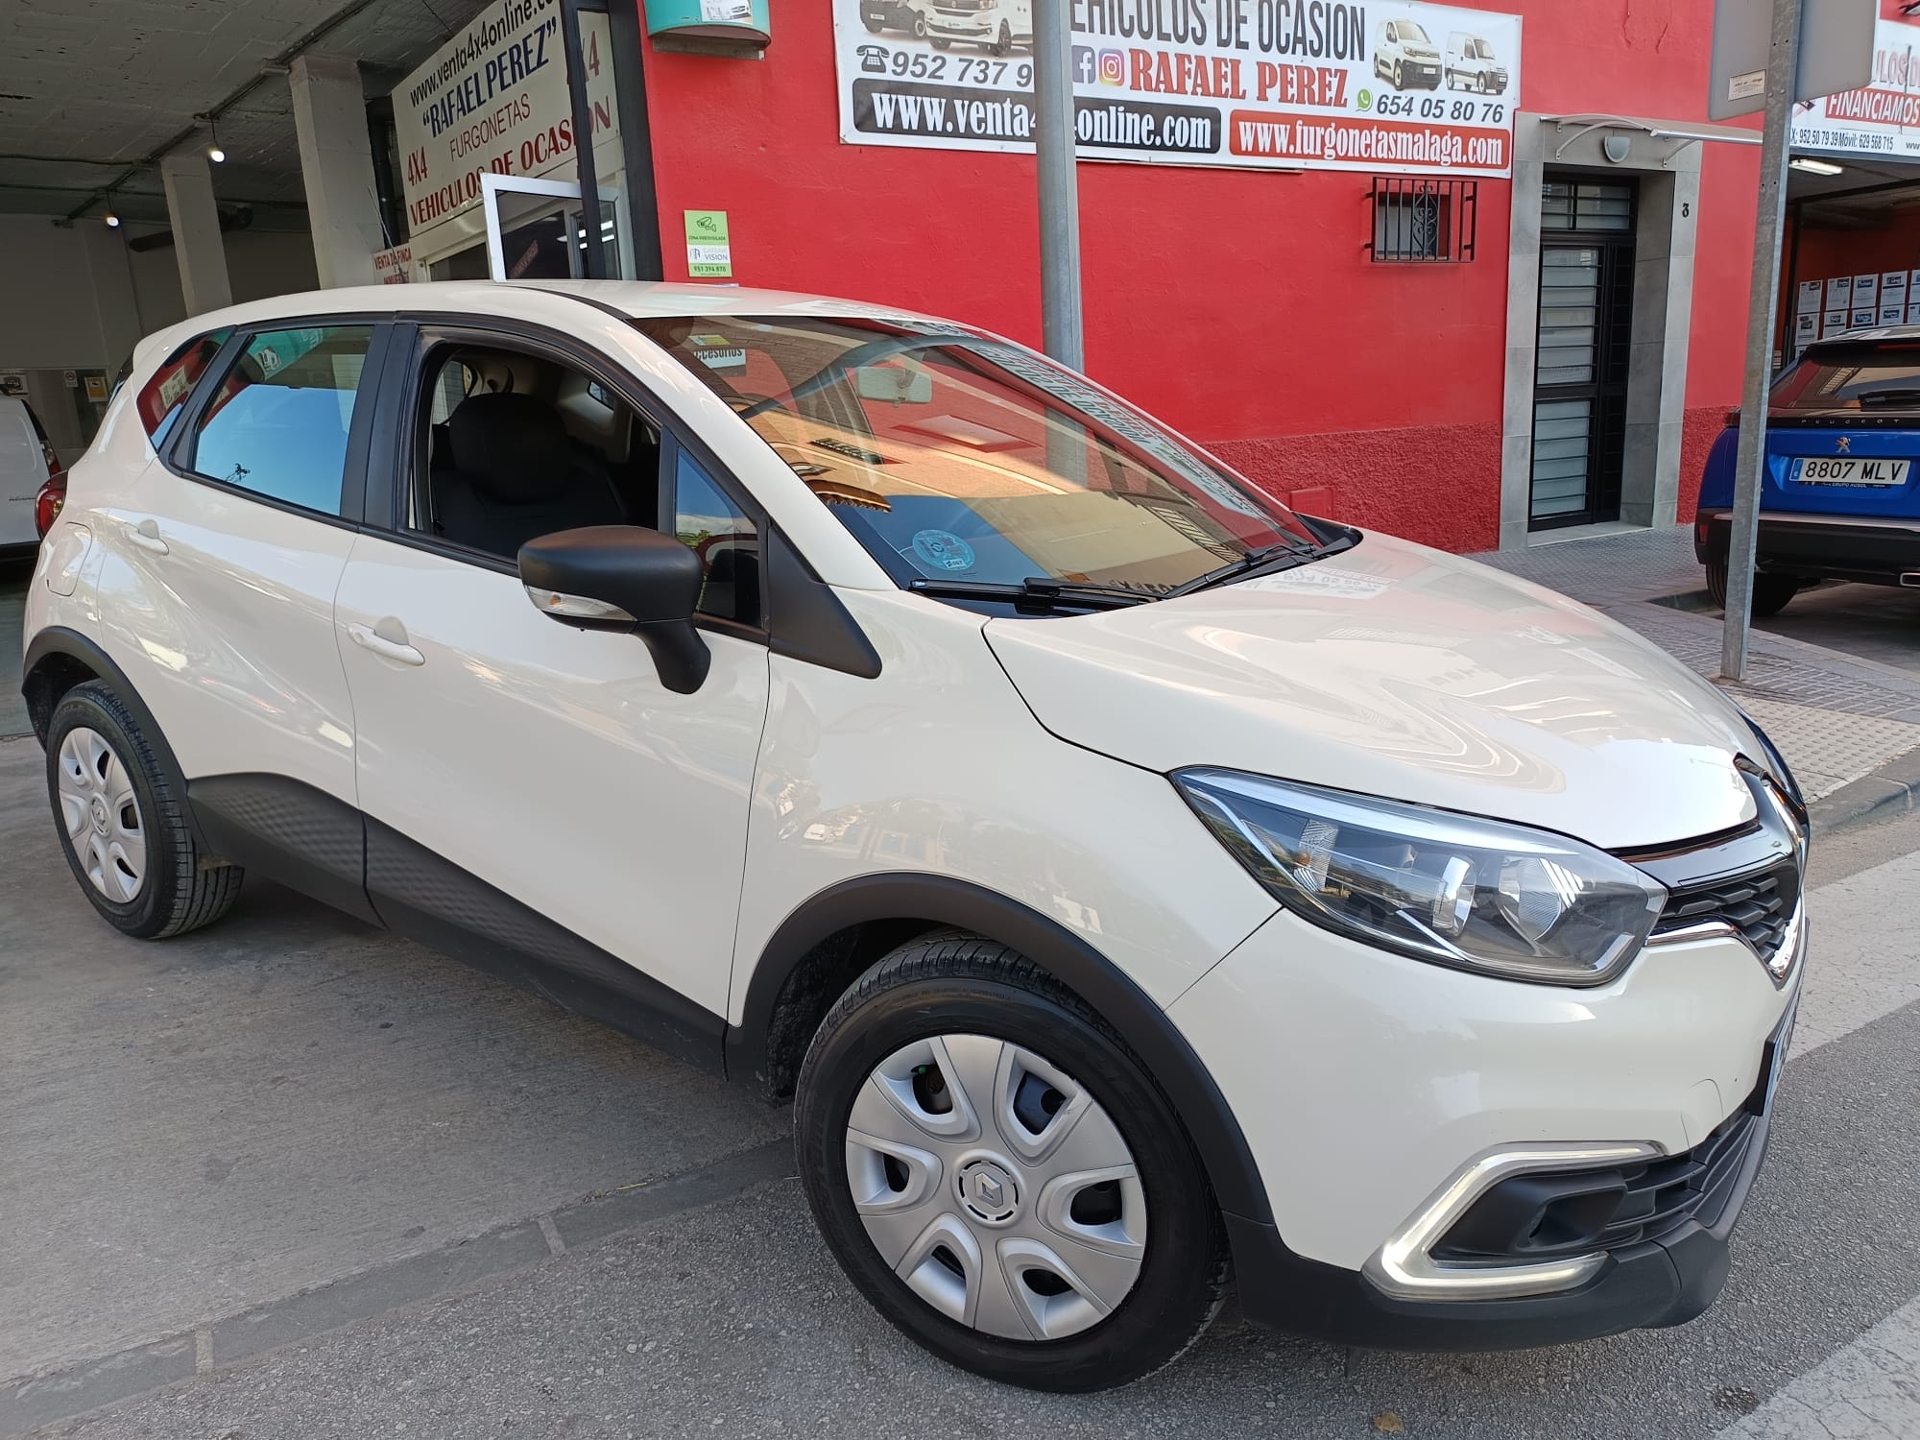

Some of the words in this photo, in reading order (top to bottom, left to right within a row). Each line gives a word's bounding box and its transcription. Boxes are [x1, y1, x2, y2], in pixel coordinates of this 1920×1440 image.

[1071, 0, 1207, 46] EHICULOS
[1216, 0, 1250, 50] DE
[1258, 0, 1365, 62] OCASION
[410, 0, 555, 107] www.venta4x4online.c
[891, 51, 948, 81] 952
[957, 57, 1009, 86] 737
[1129, 48, 1246, 100] RAFAEL
[1256, 61, 1349, 108] PEREZ
[1376, 94, 1414, 117] 654
[1420, 98, 1445, 119] 05
[1450, 101, 1475, 121] 80
[1481, 104, 1504, 124] 76
[1828, 90, 1919, 124] FINANCIAMOS
[407, 146, 428, 187] 4X4
[449, 93, 531, 162] FURGONETAS
[1238, 119, 1502, 166] www.furgonetasmalaga.com
[410, 166, 483, 227] VEHICULOS
[1682, 202, 1690, 218] 3
[703, 253, 728, 261] VISION
[1805, 461, 1856, 480] 8807
[1860, 462, 1904, 481] MLV
